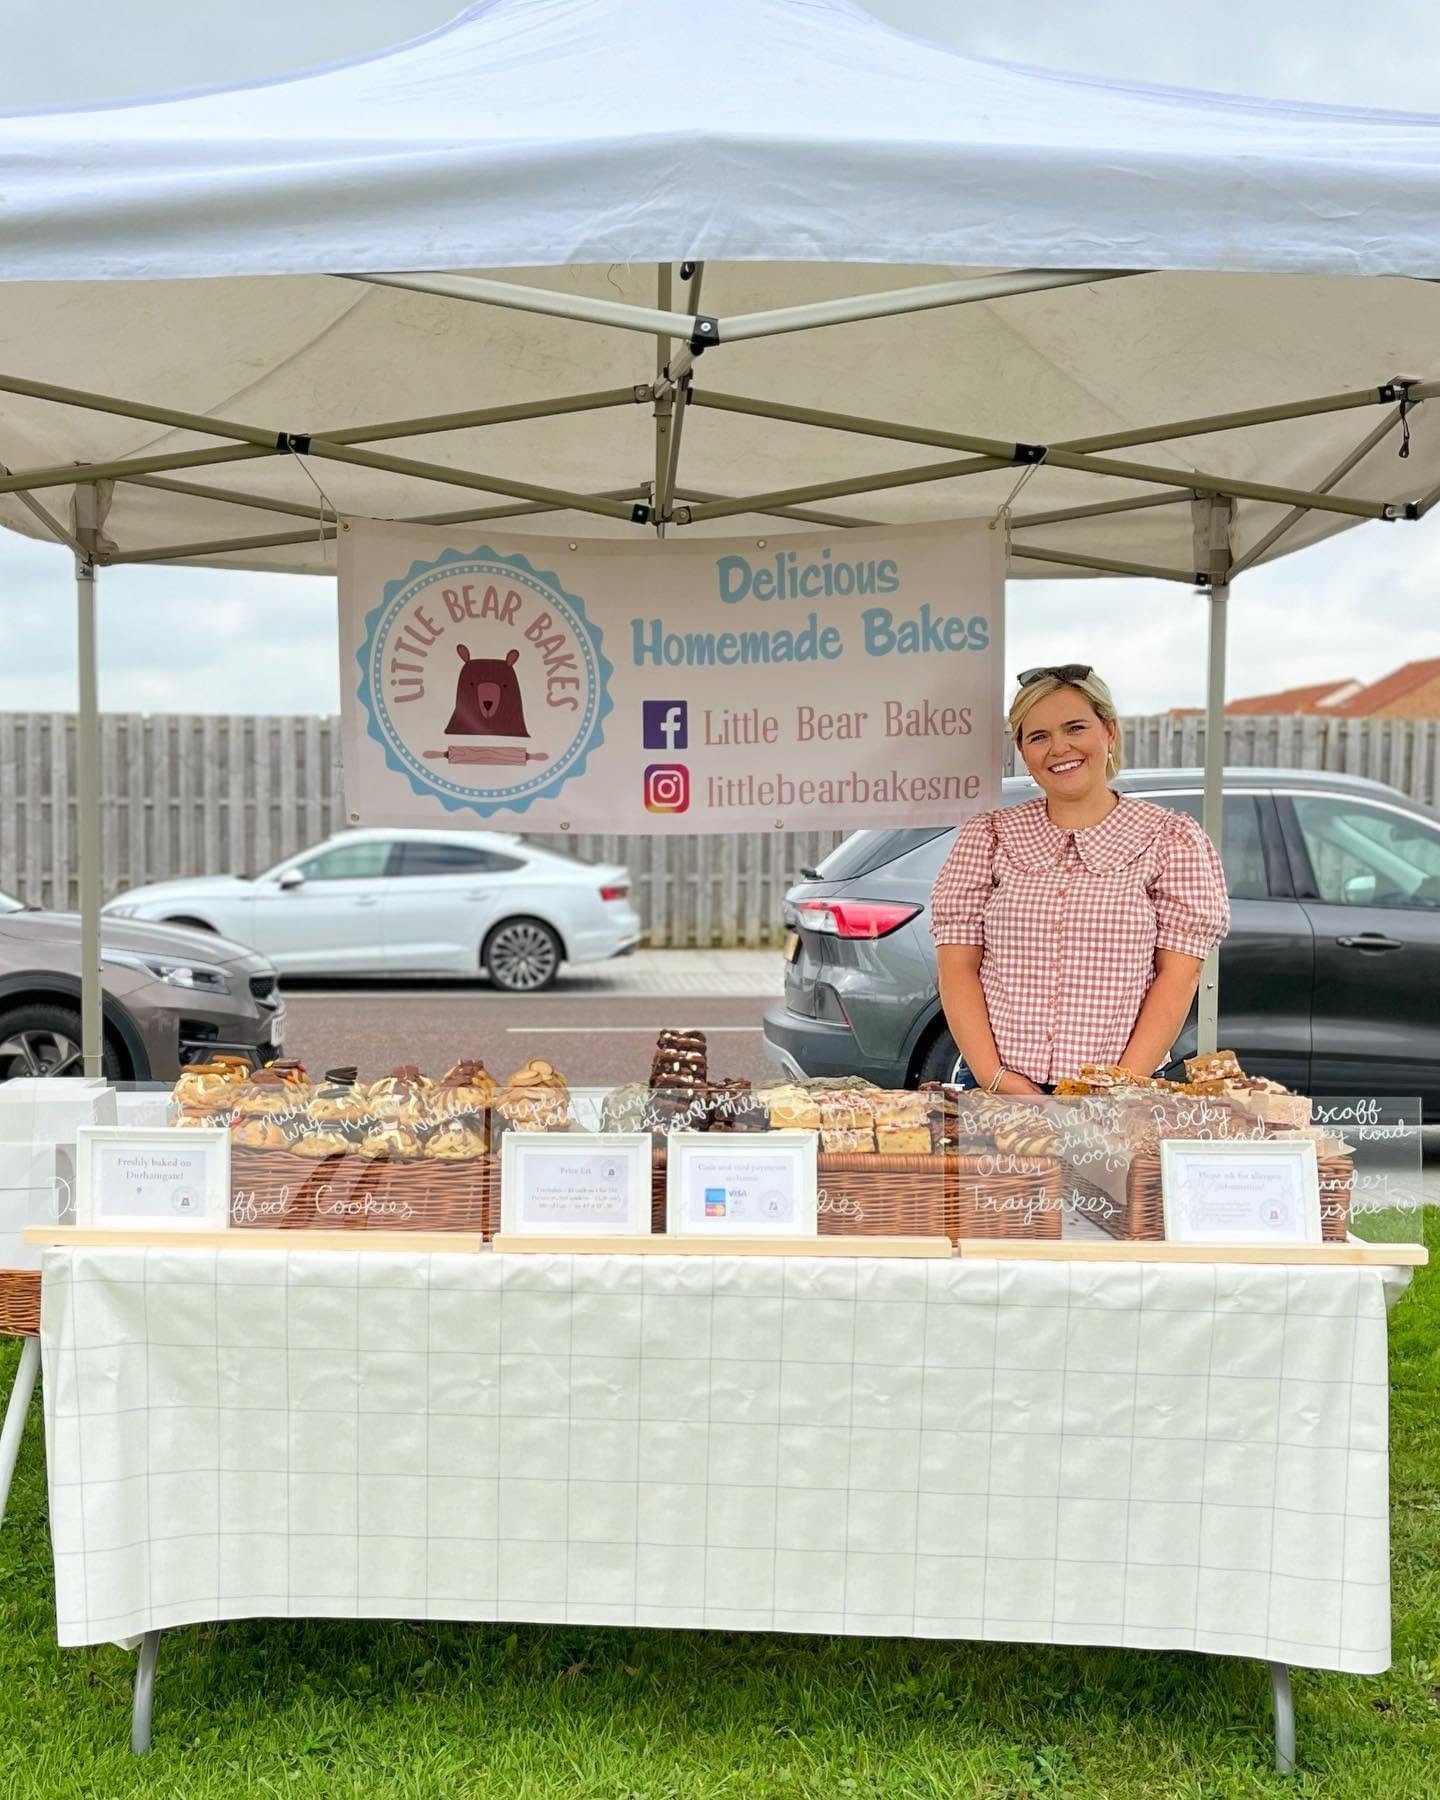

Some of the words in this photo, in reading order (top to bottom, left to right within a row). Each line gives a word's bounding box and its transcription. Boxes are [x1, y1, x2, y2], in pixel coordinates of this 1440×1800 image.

[716, 549, 900, 604] Delicious
[442, 585, 523, 627] BEAR
[524, 612, 580, 712] BAKES
[630, 612, 844, 667] Homemade
[861, 603, 990, 657] Bakes
[703, 708, 779, 746] Little
[796, 705, 869, 742] Bear
[883, 699, 973, 738] Bakes
[706, 770, 981, 808] littlebearbakesne
[1151, 1099, 1231, 1137] Rocky
[1359, 1119, 1418, 1142] Road
[977, 1154, 1044, 1177] Other
[1316, 1169, 1399, 1194] inder
[315, 1184, 417, 1220] Cookies
[966, 1184, 1122, 1225] Traybakes
